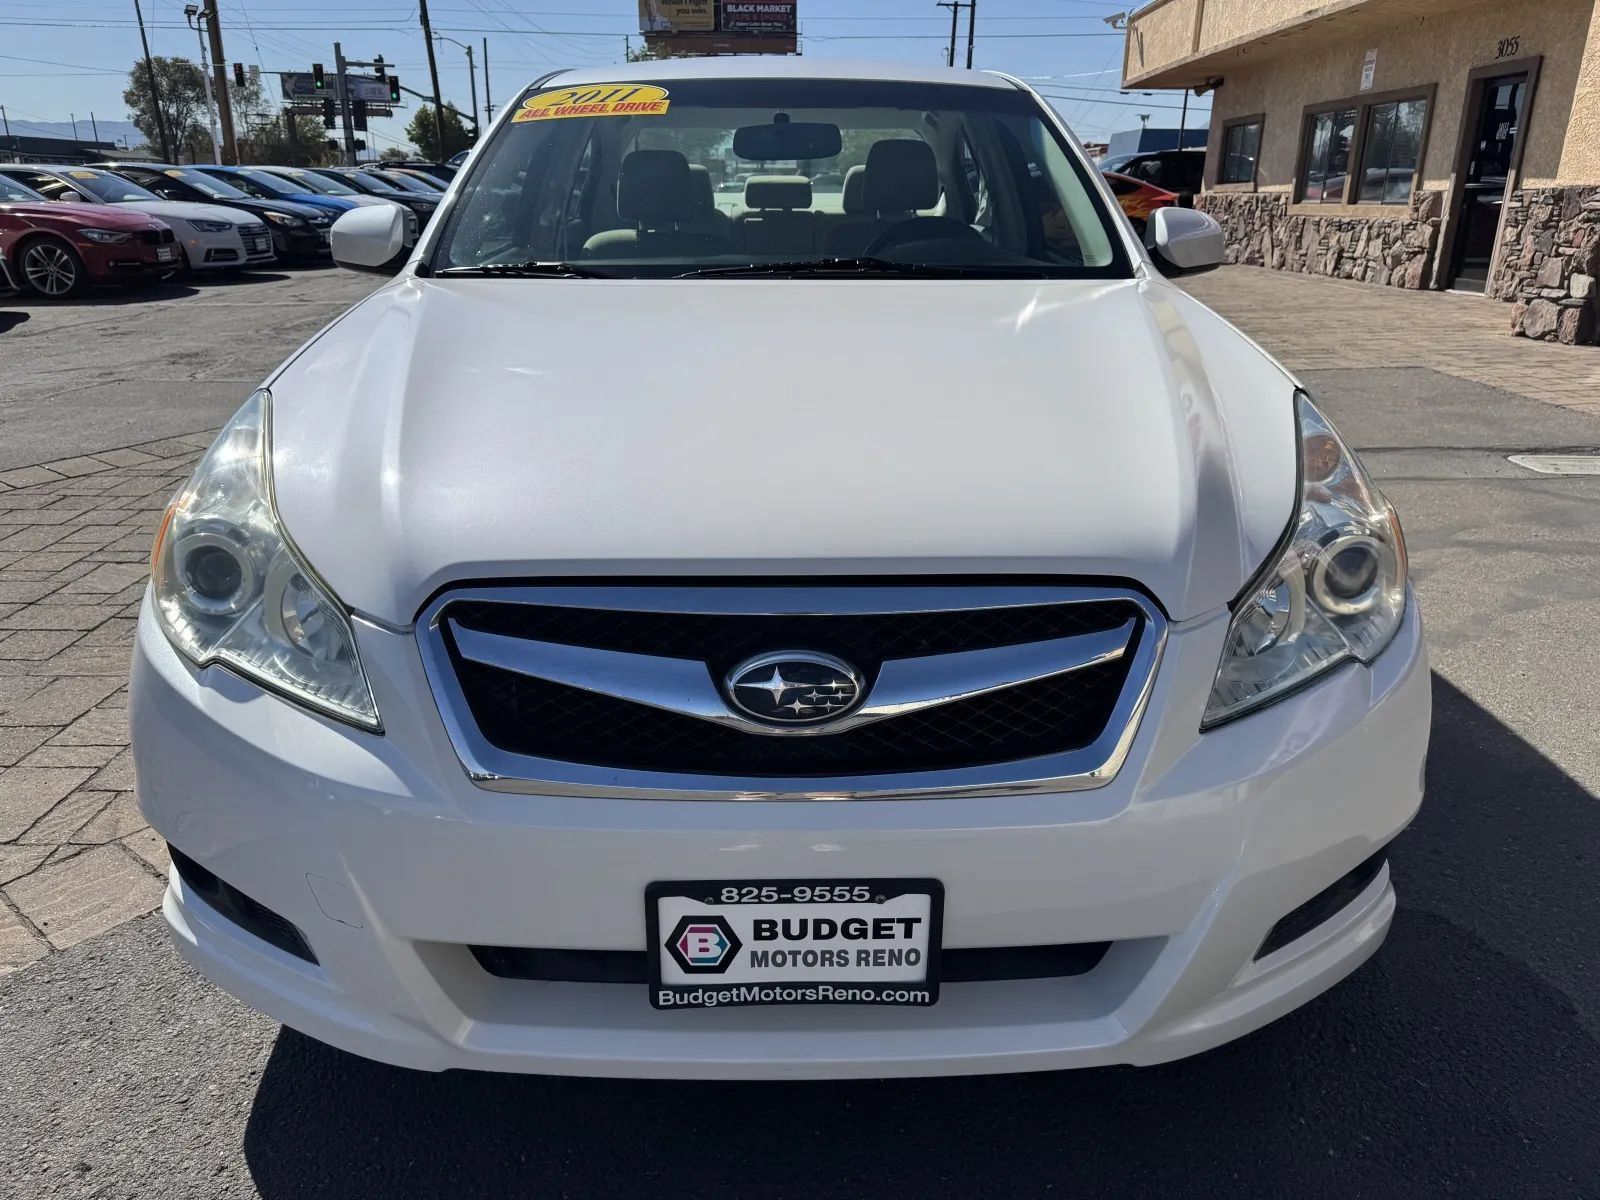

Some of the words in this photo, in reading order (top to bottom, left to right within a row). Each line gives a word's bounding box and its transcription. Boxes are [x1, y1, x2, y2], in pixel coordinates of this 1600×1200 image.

[676, 8, 690, 16] you
[727, 4, 755, 13] BLACK
[756, 4, 792, 13] MARKET
[1495, 35, 1520, 59] 3055
[547, 87, 643, 107] 2011
[519, 107, 549, 119] ALL
[554, 103, 607, 116] WHEEL
[611, 101, 663, 112] DRIVE
[720, 886, 871, 903] 825-9555
[752, 917, 922, 941] BUDGET
[687, 932, 722, 959] B
[750, 949, 850, 968] MOTORS
[855, 947, 922, 967] RENO
[658, 985, 931, 1007] BudgetMotorsReno.com
